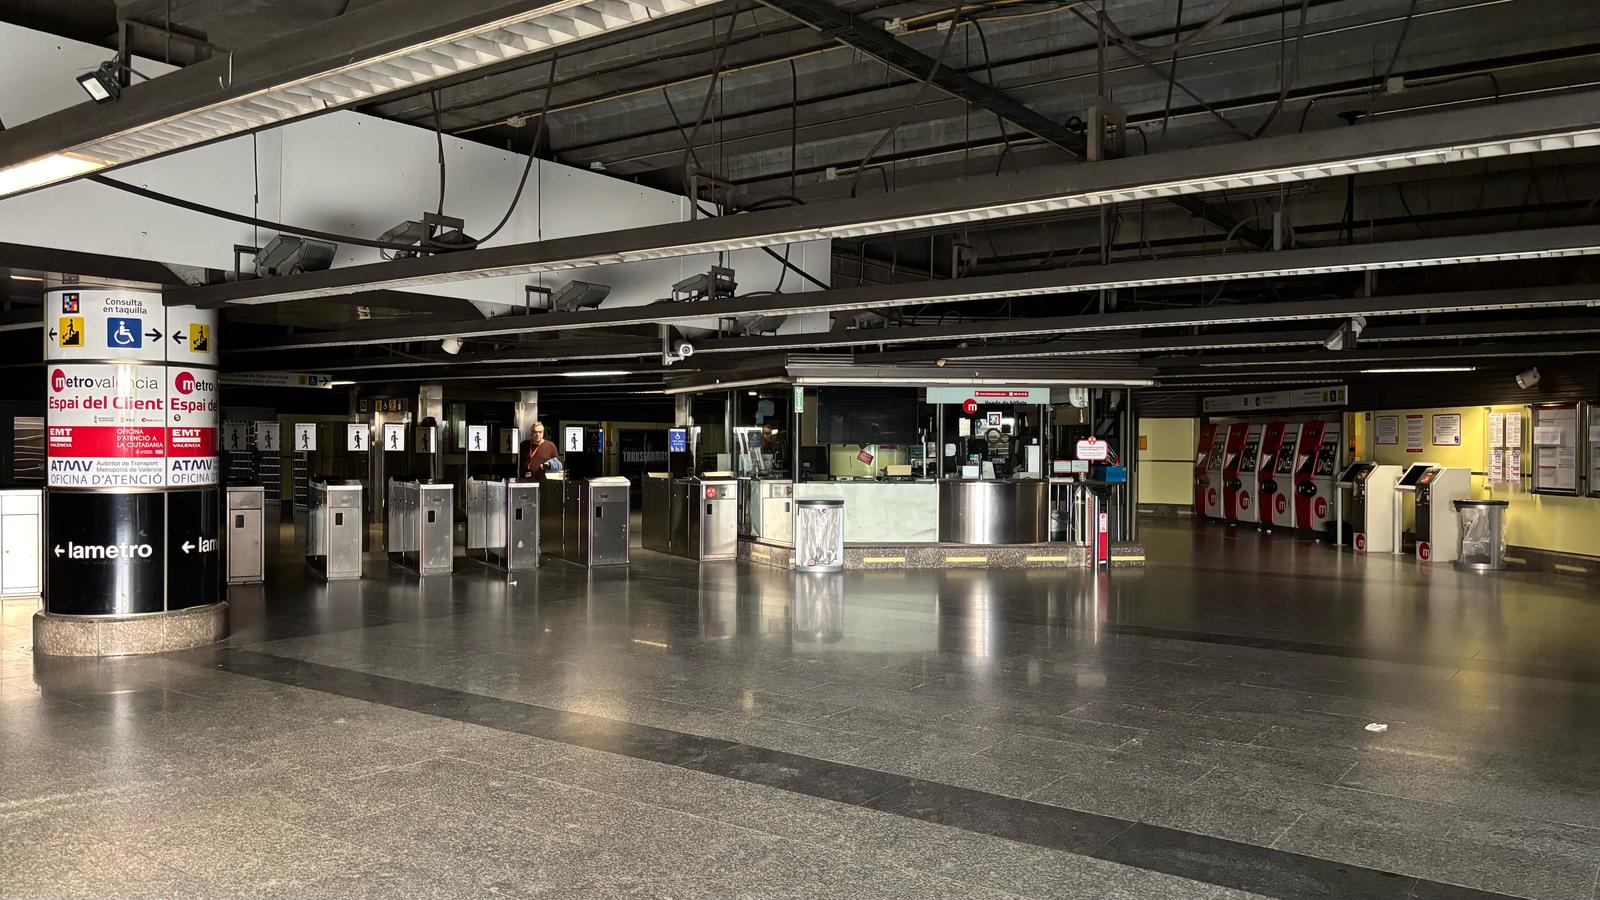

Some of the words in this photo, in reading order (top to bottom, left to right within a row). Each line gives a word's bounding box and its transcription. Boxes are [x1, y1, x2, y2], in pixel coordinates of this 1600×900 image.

[105, 297, 143, 307] Consulta
[102, 306, 114, 314] en
[115, 305, 148, 315] taquilla
[54, 374, 158, 390] metrovalncia
[49, 396, 79, 411] Espai
[83, 396, 107, 409] del
[113, 397, 163, 410] Client
[171, 398, 205, 413] Espai
[50, 428, 73, 436] EMT
[172, 429, 201, 437] EMT
[51, 460, 94, 472] ATMV
[172, 459, 213, 471] ATMV
[51, 473, 88, 485] OFICINA
[92, 472, 163, 485] D'ATENCIÓ
[172, 472, 210, 484] OFICINA
[68, 541, 153, 559] lametro
